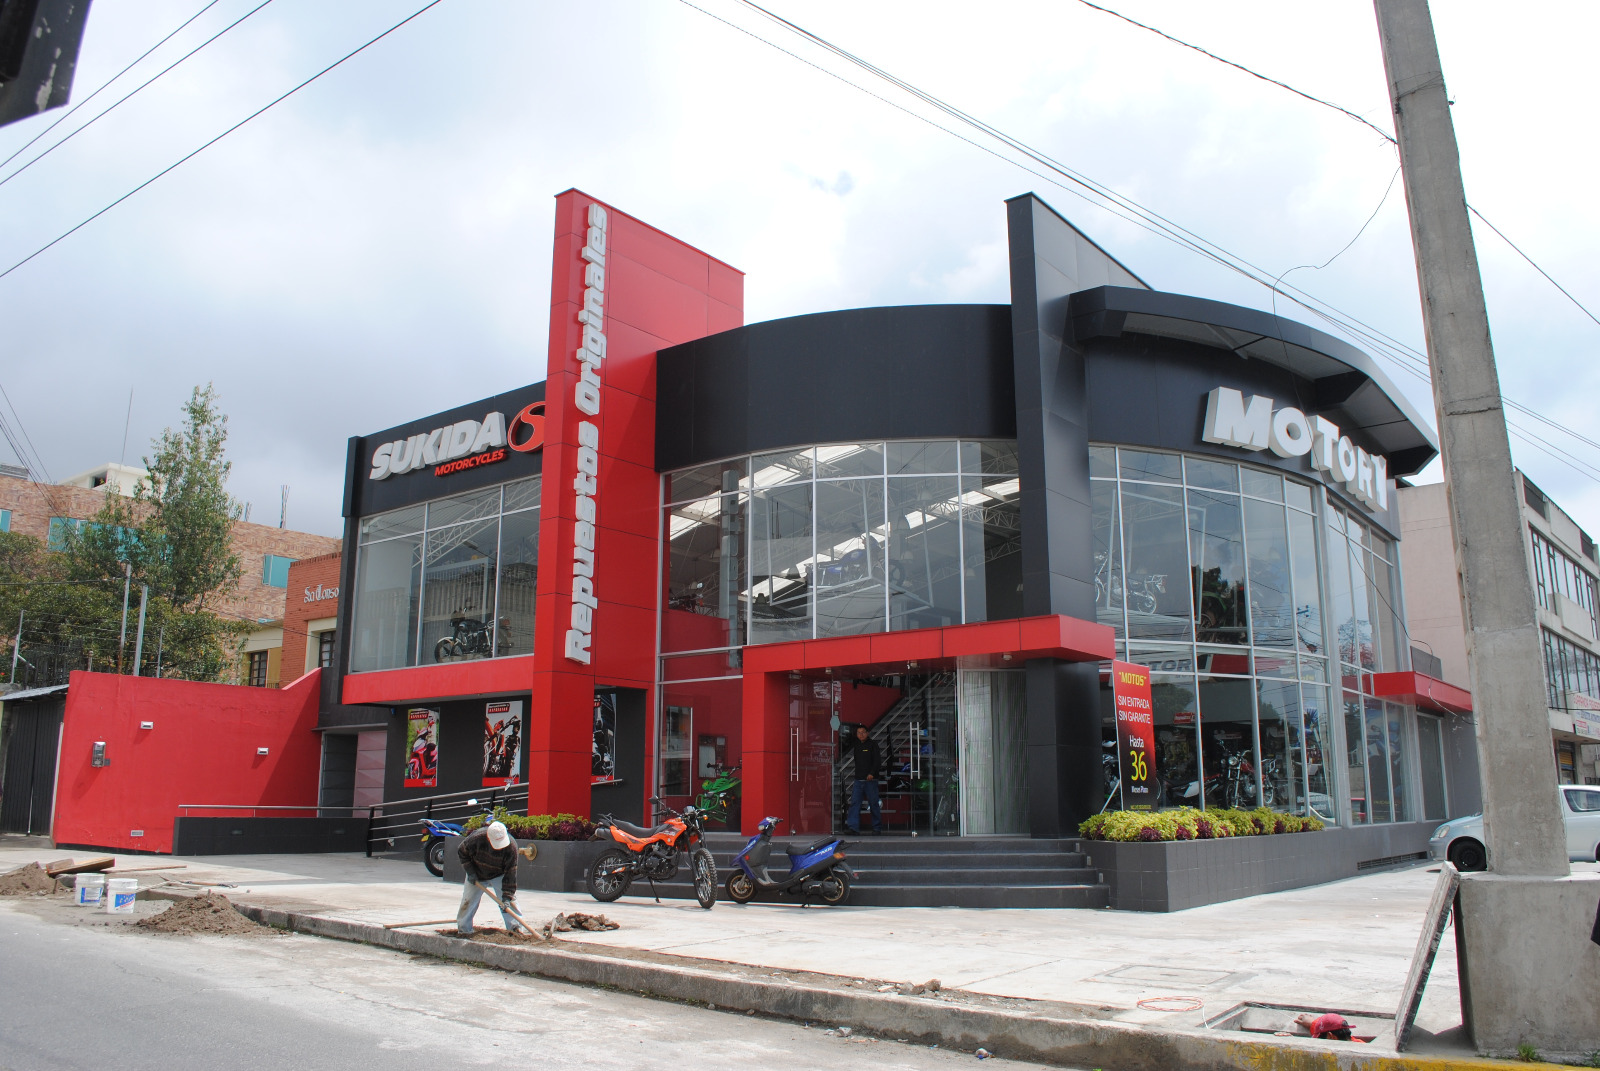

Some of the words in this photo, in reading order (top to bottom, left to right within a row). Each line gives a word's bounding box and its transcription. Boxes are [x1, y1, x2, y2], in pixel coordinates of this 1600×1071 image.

[575, 203, 608, 416] Originales
[369, 411, 507, 481] SUKIDA
[434, 447, 507, 477] MOTORCYCLES
[565, 420, 600, 665] Repuestos
[1117, 694, 1127, 706] SIN
[1127, 696, 1151, 710] ENTRADA
[1118, 709, 1128, 721] SIN
[1128, 711, 1152, 724] GARANTE
[1129, 735, 1144, 748] Hasta
[1129, 749, 1147, 782] 36
